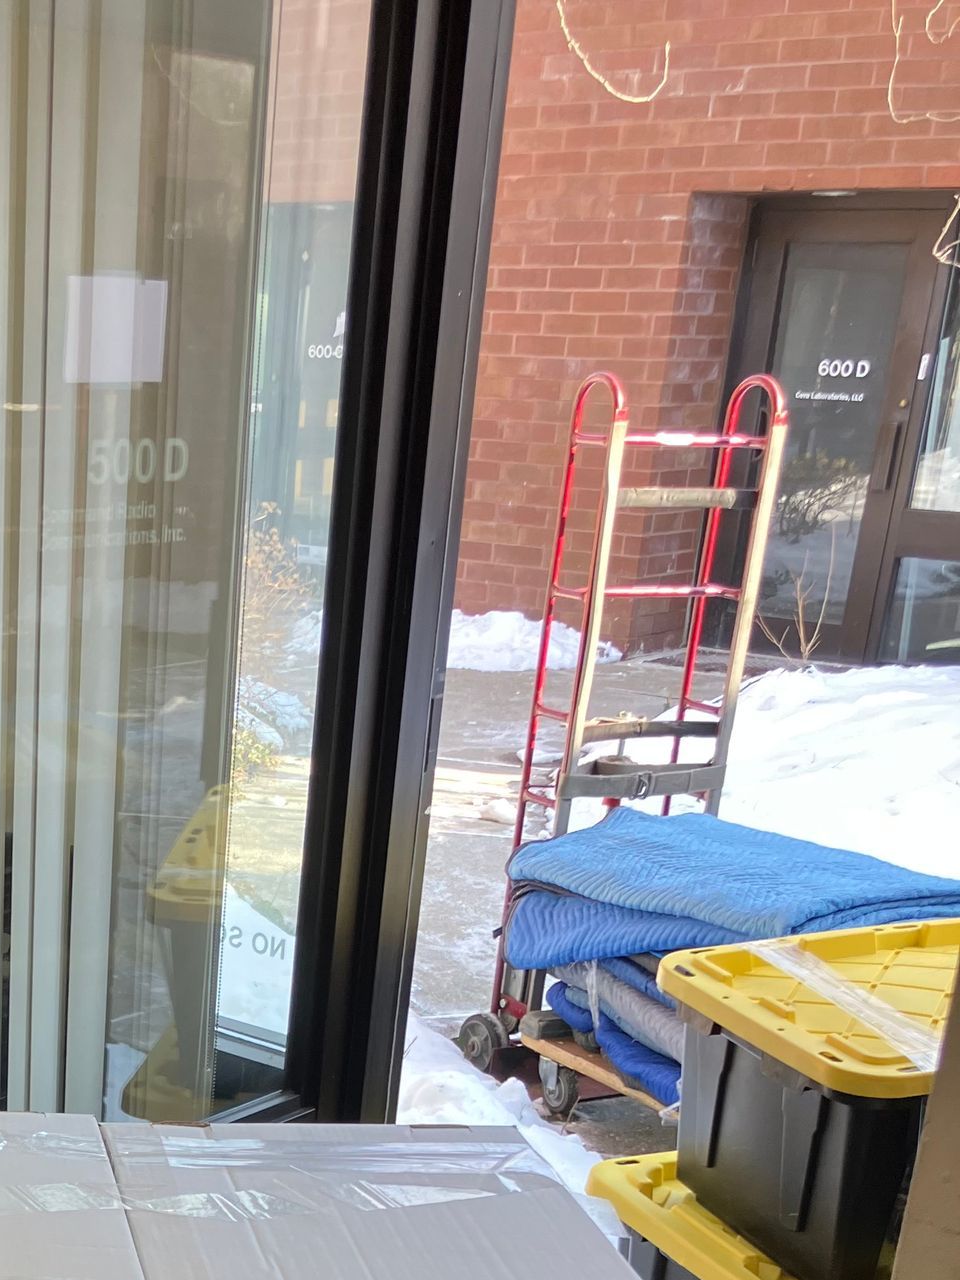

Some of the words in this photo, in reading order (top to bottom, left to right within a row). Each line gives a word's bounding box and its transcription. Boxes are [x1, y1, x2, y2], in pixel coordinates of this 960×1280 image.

[817, 358, 854, 378] 600
[855, 359, 871, 378] D
[851, 392, 865, 402] LLC
[87, 437, 157, 485] 500
[163, 437, 190, 482] D
[162, 523, 187, 542] Inc.
